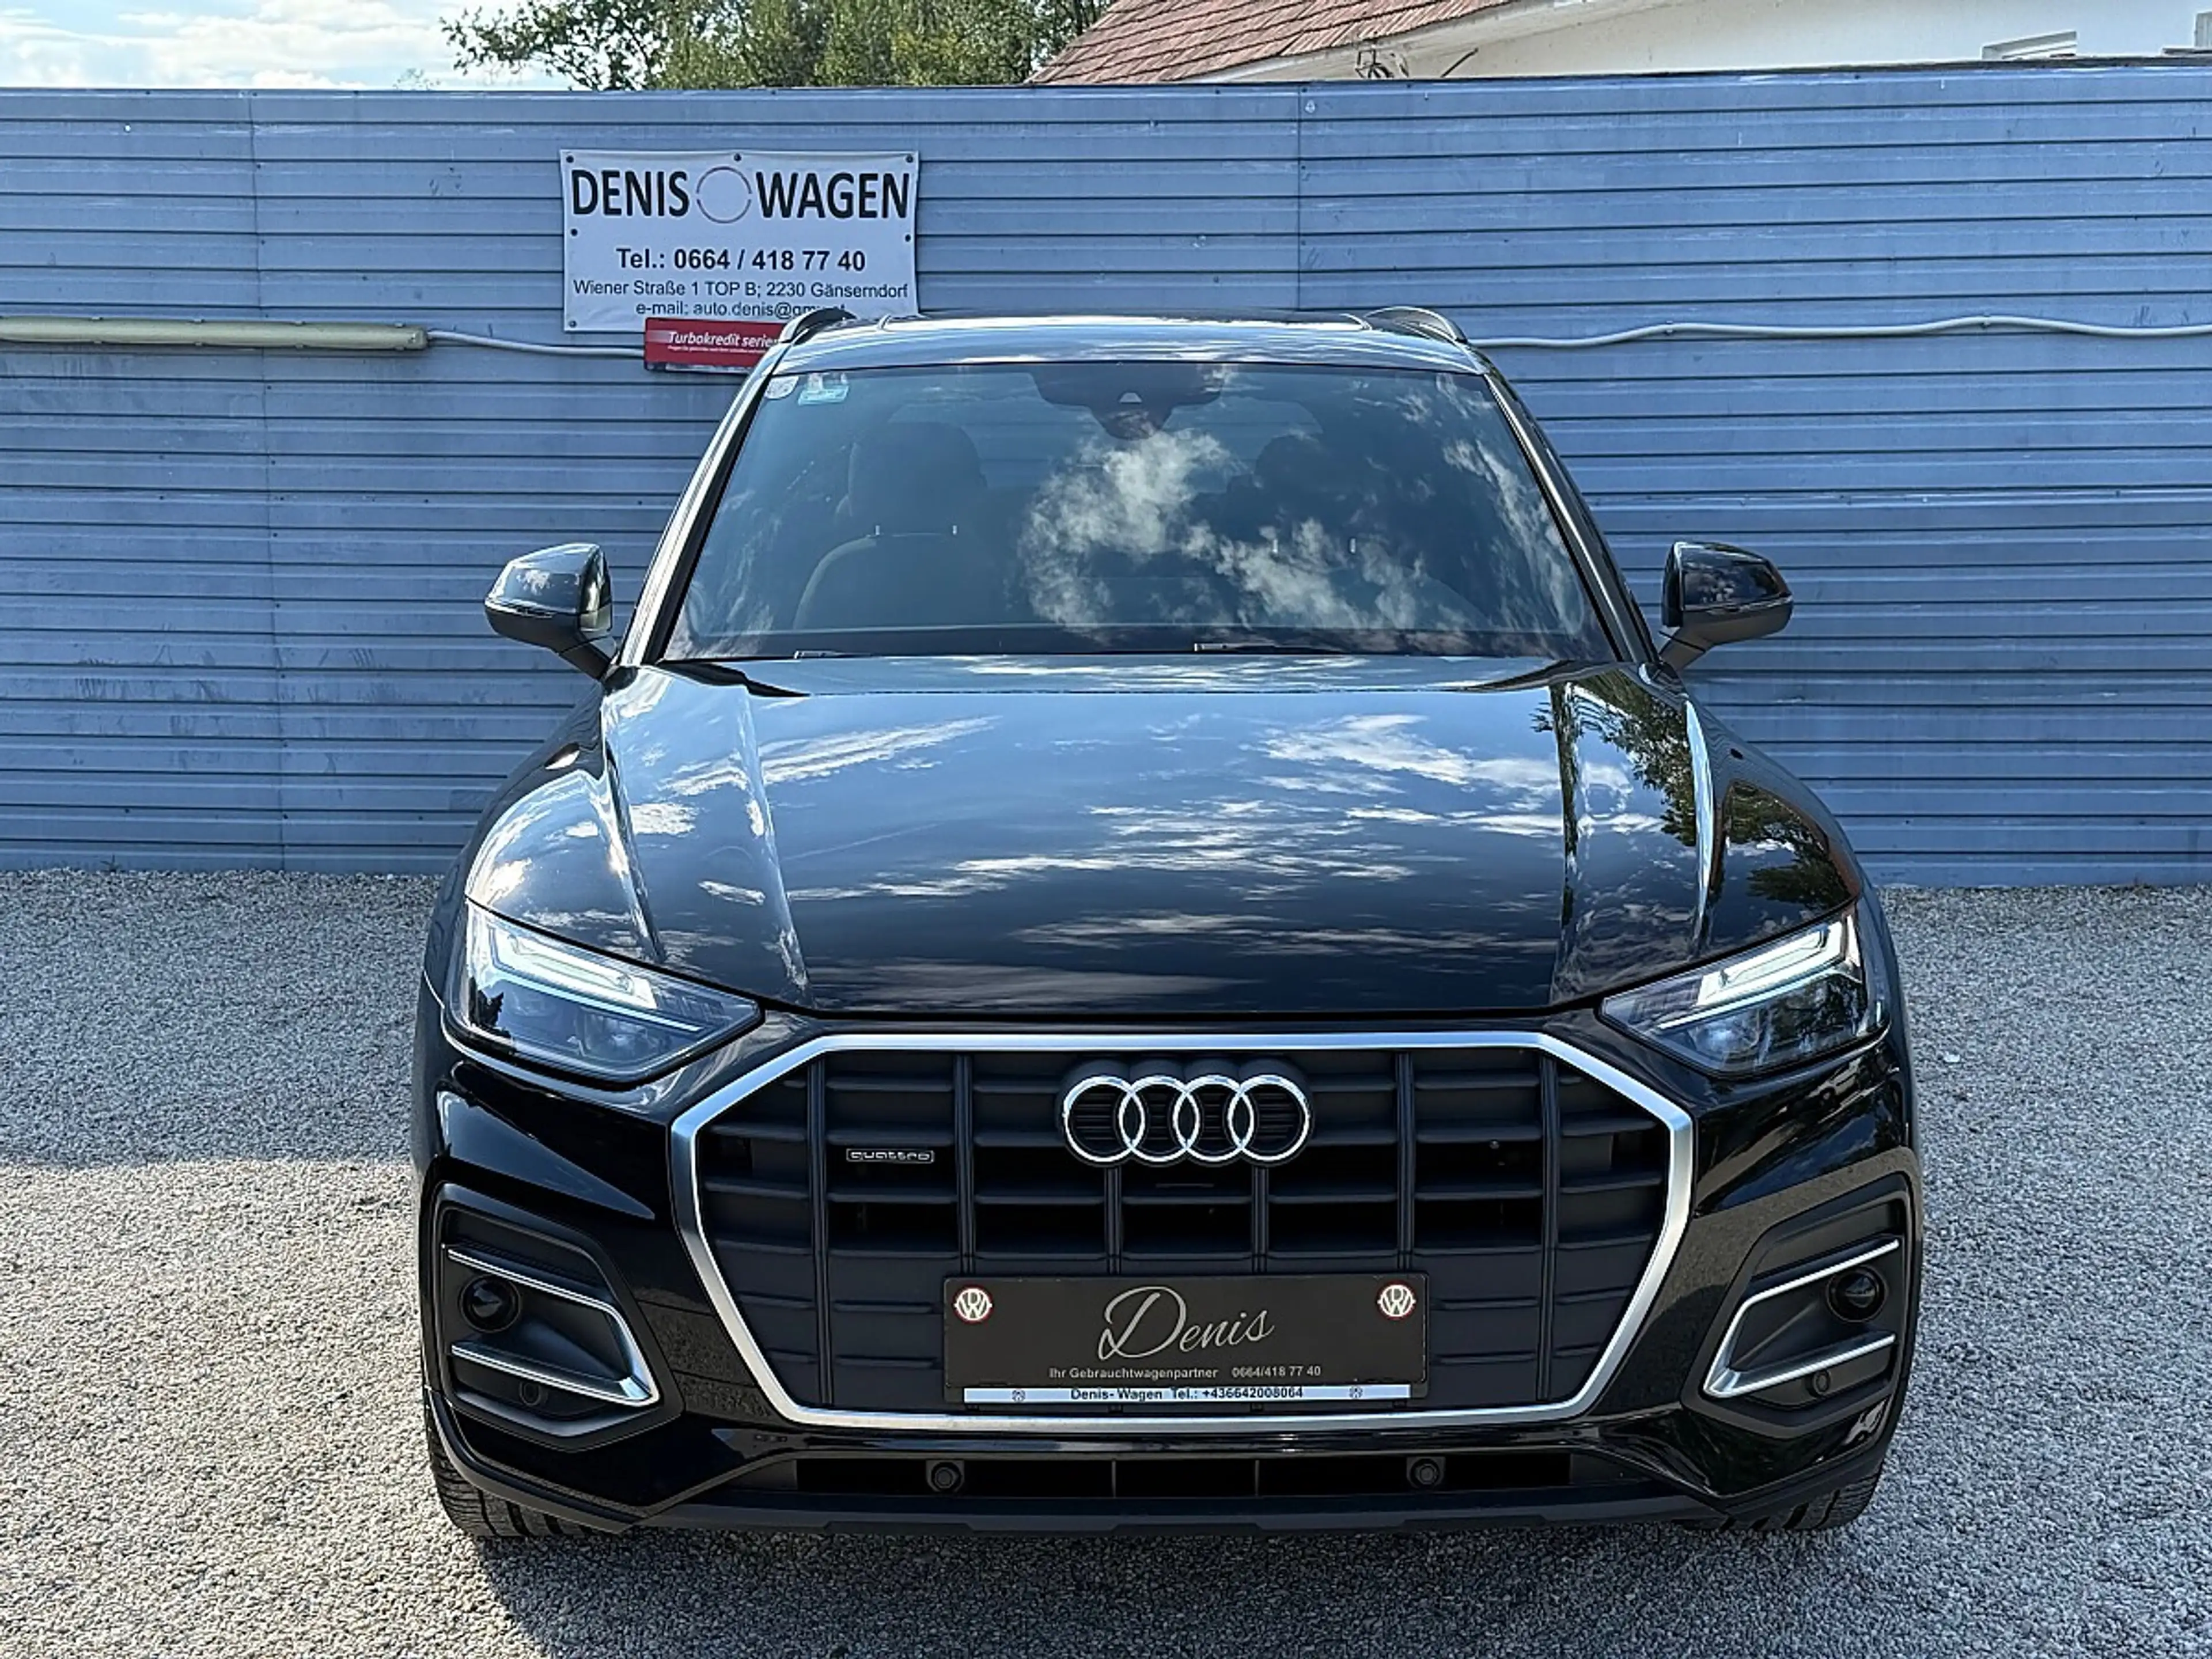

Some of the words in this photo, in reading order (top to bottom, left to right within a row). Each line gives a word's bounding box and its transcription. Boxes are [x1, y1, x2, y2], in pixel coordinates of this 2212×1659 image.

[571, 169, 690, 217] DENIS
[755, 172, 910, 218] WAGEN
[616, 248, 665, 269] Tel.:
[674, 248, 730, 270] 0664
[737, 249, 745, 270] /
[752, 250, 794, 270] 418
[802, 250, 830, 270] 77
[838, 251, 865, 271] 40
[573, 279, 629, 294] Wiener
[634, 280, 685, 296] Straße
[691, 281, 698, 296] 1
[704, 282, 740, 296] TOP
[745, 282, 761, 298] B;
[766, 282, 805, 297] 2230
[810, 282, 908, 298] Gänserndorf
[636, 301, 689, 315] e-mail:
[668, 331, 740, 347] Turbokredit
[850, 1151, 930, 1161] quattro
[1098, 1285, 1275, 1361] Denis
[1049, 1368, 1066, 1378] Ihr
[1069, 1367, 1218, 1381] Gebrauchtwagenpartner
[1231, 1365, 1286, 1378] 0664/418
[1289, 1366, 1304, 1377] 77
[1306, 1365, 1321, 1376] 40
[1117, 1388, 1162, 1402] Wagen
[1171, 1388, 1198, 1400] Tel.:
